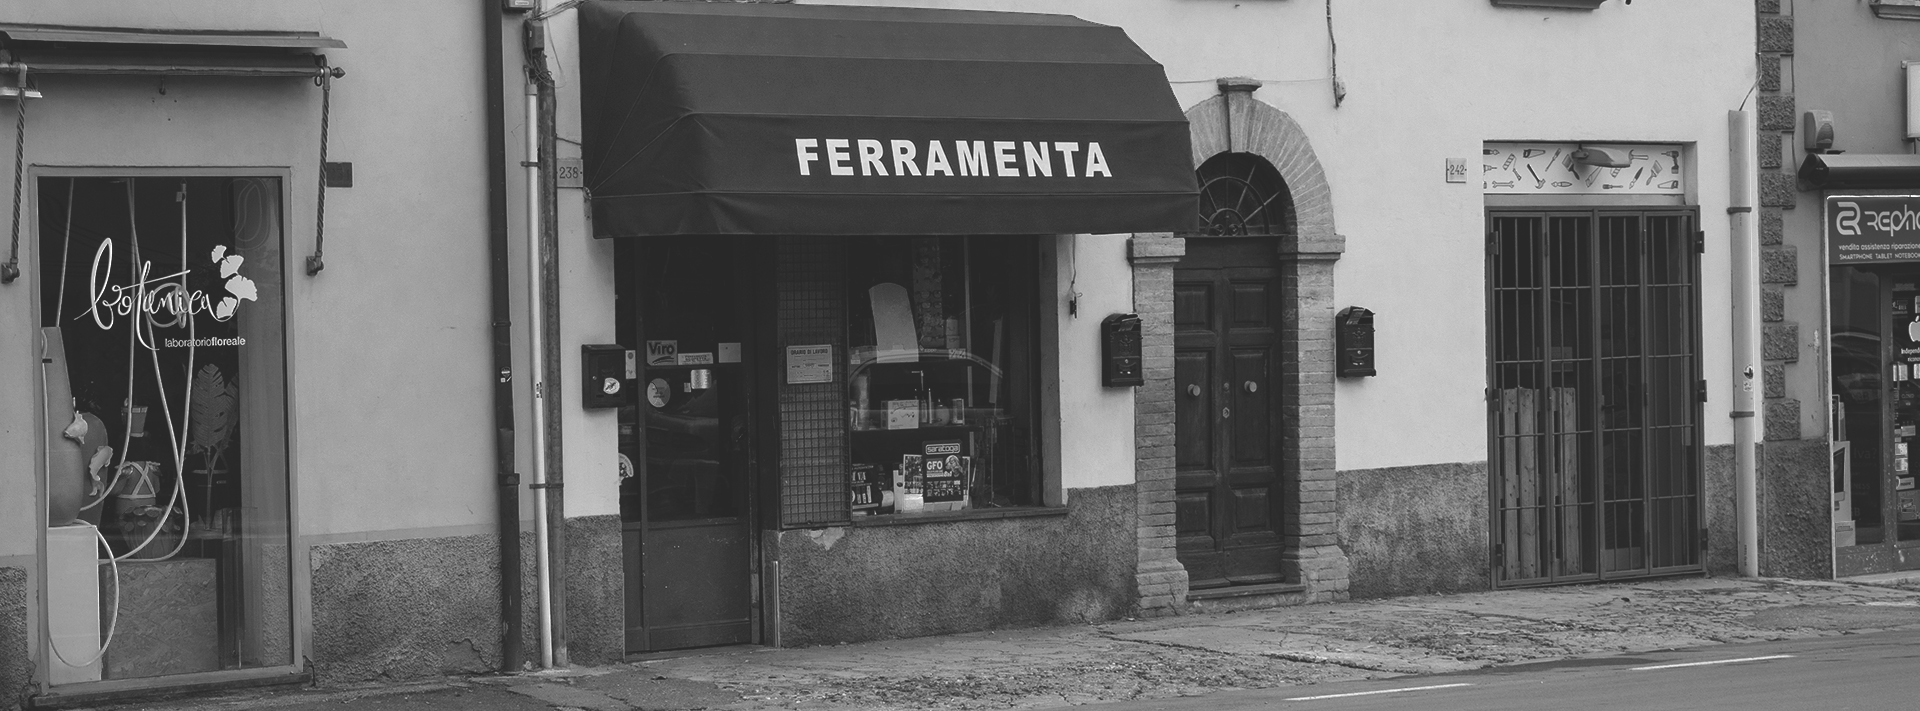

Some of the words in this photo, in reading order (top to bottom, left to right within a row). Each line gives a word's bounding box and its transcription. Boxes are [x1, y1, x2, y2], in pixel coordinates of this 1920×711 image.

[795, 138, 1113, 178] FERRAMENTA
[559, 166, 579, 179] 238
[1450, 164, 1465, 175] 242
[1839, 243, 1860, 251] vendita
[1860, 242, 1891, 251] assistenza
[1839, 253, 1873, 261] SMARTPHONE
[74, 237, 232, 351] botanica
[164, 336, 246, 348] laboratoriofloreale
[648, 342, 675, 355] Viro
[927, 445, 959, 454] saratoga
[926, 460, 943, 470] GFO
